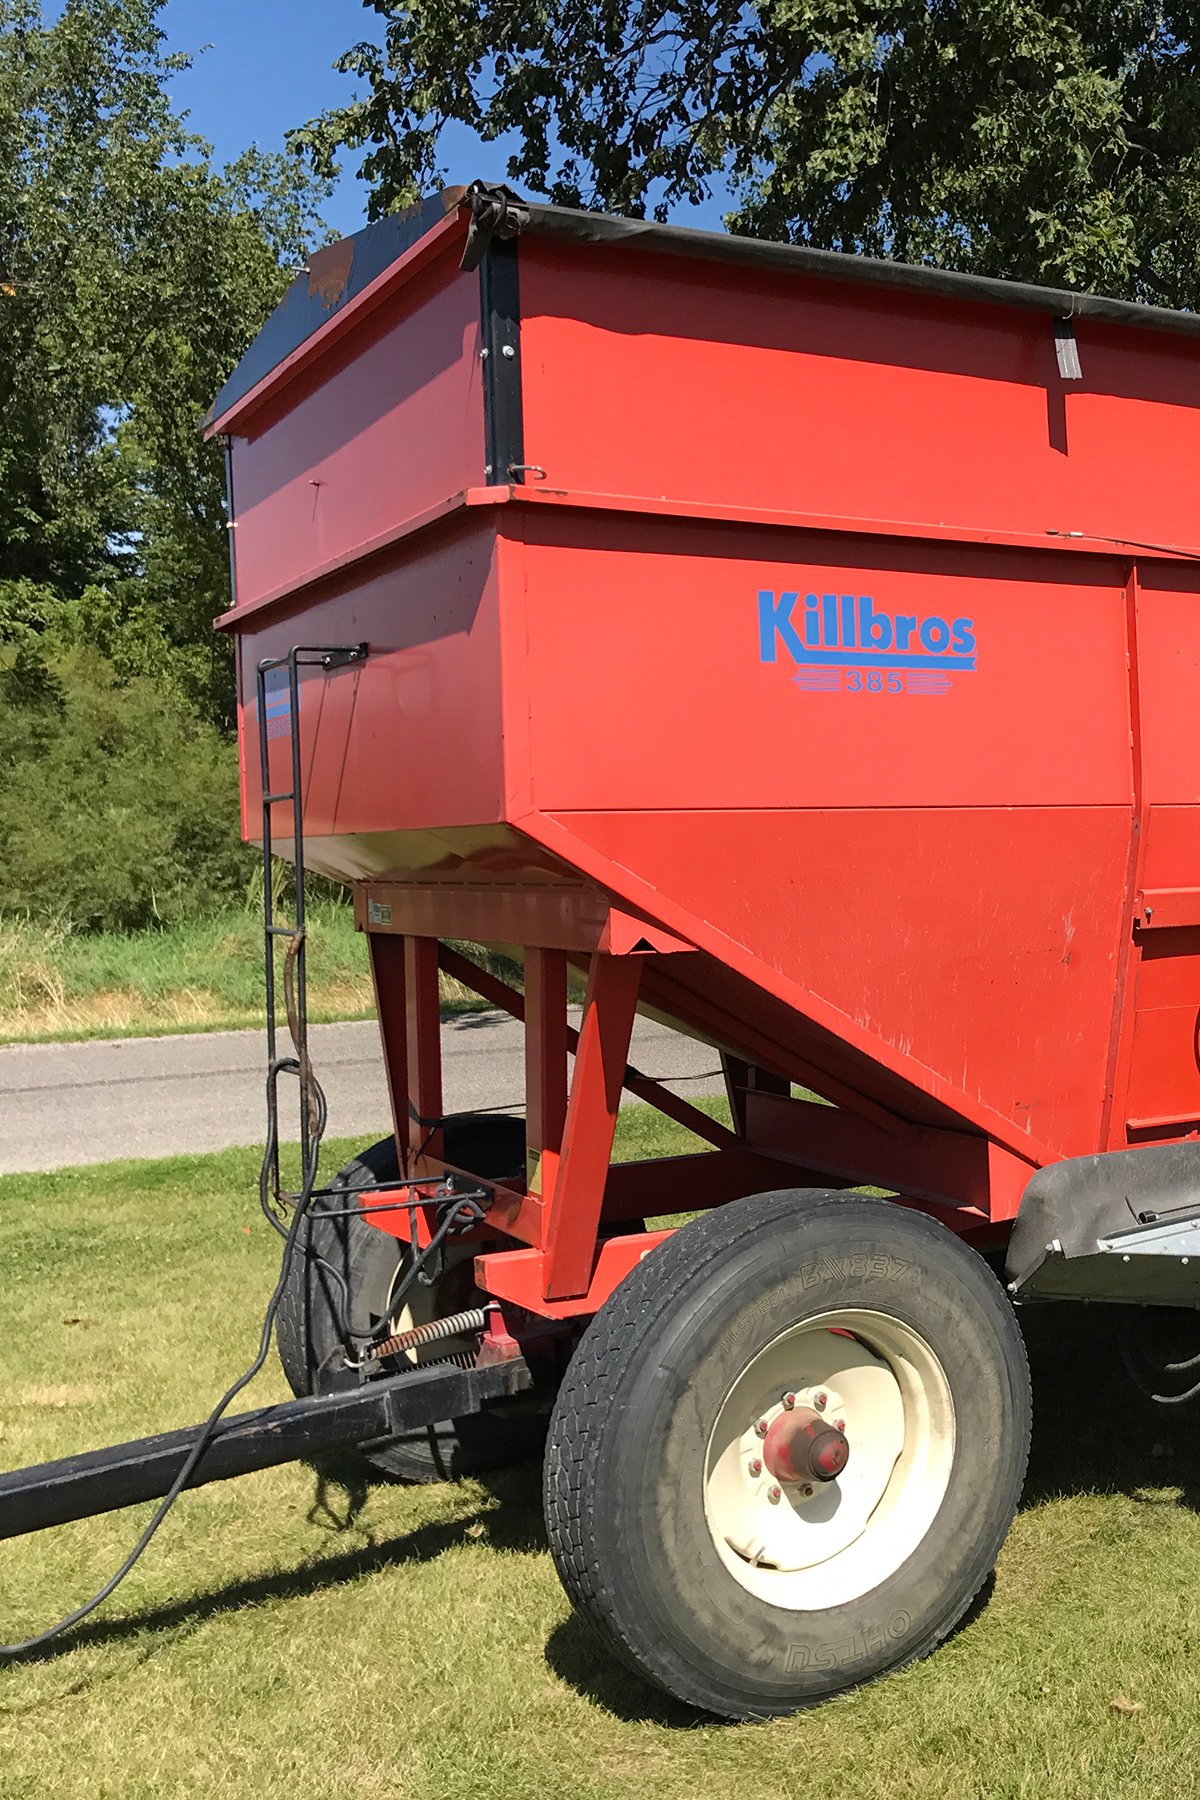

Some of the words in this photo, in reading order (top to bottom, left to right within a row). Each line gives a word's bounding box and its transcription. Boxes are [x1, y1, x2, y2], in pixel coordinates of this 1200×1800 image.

[757, 590, 977, 668] Killbros
[846, 671, 903, 693] 385
[800, 1253, 911, 1290] BX837
[785, 1609, 912, 1673] OHTSU
